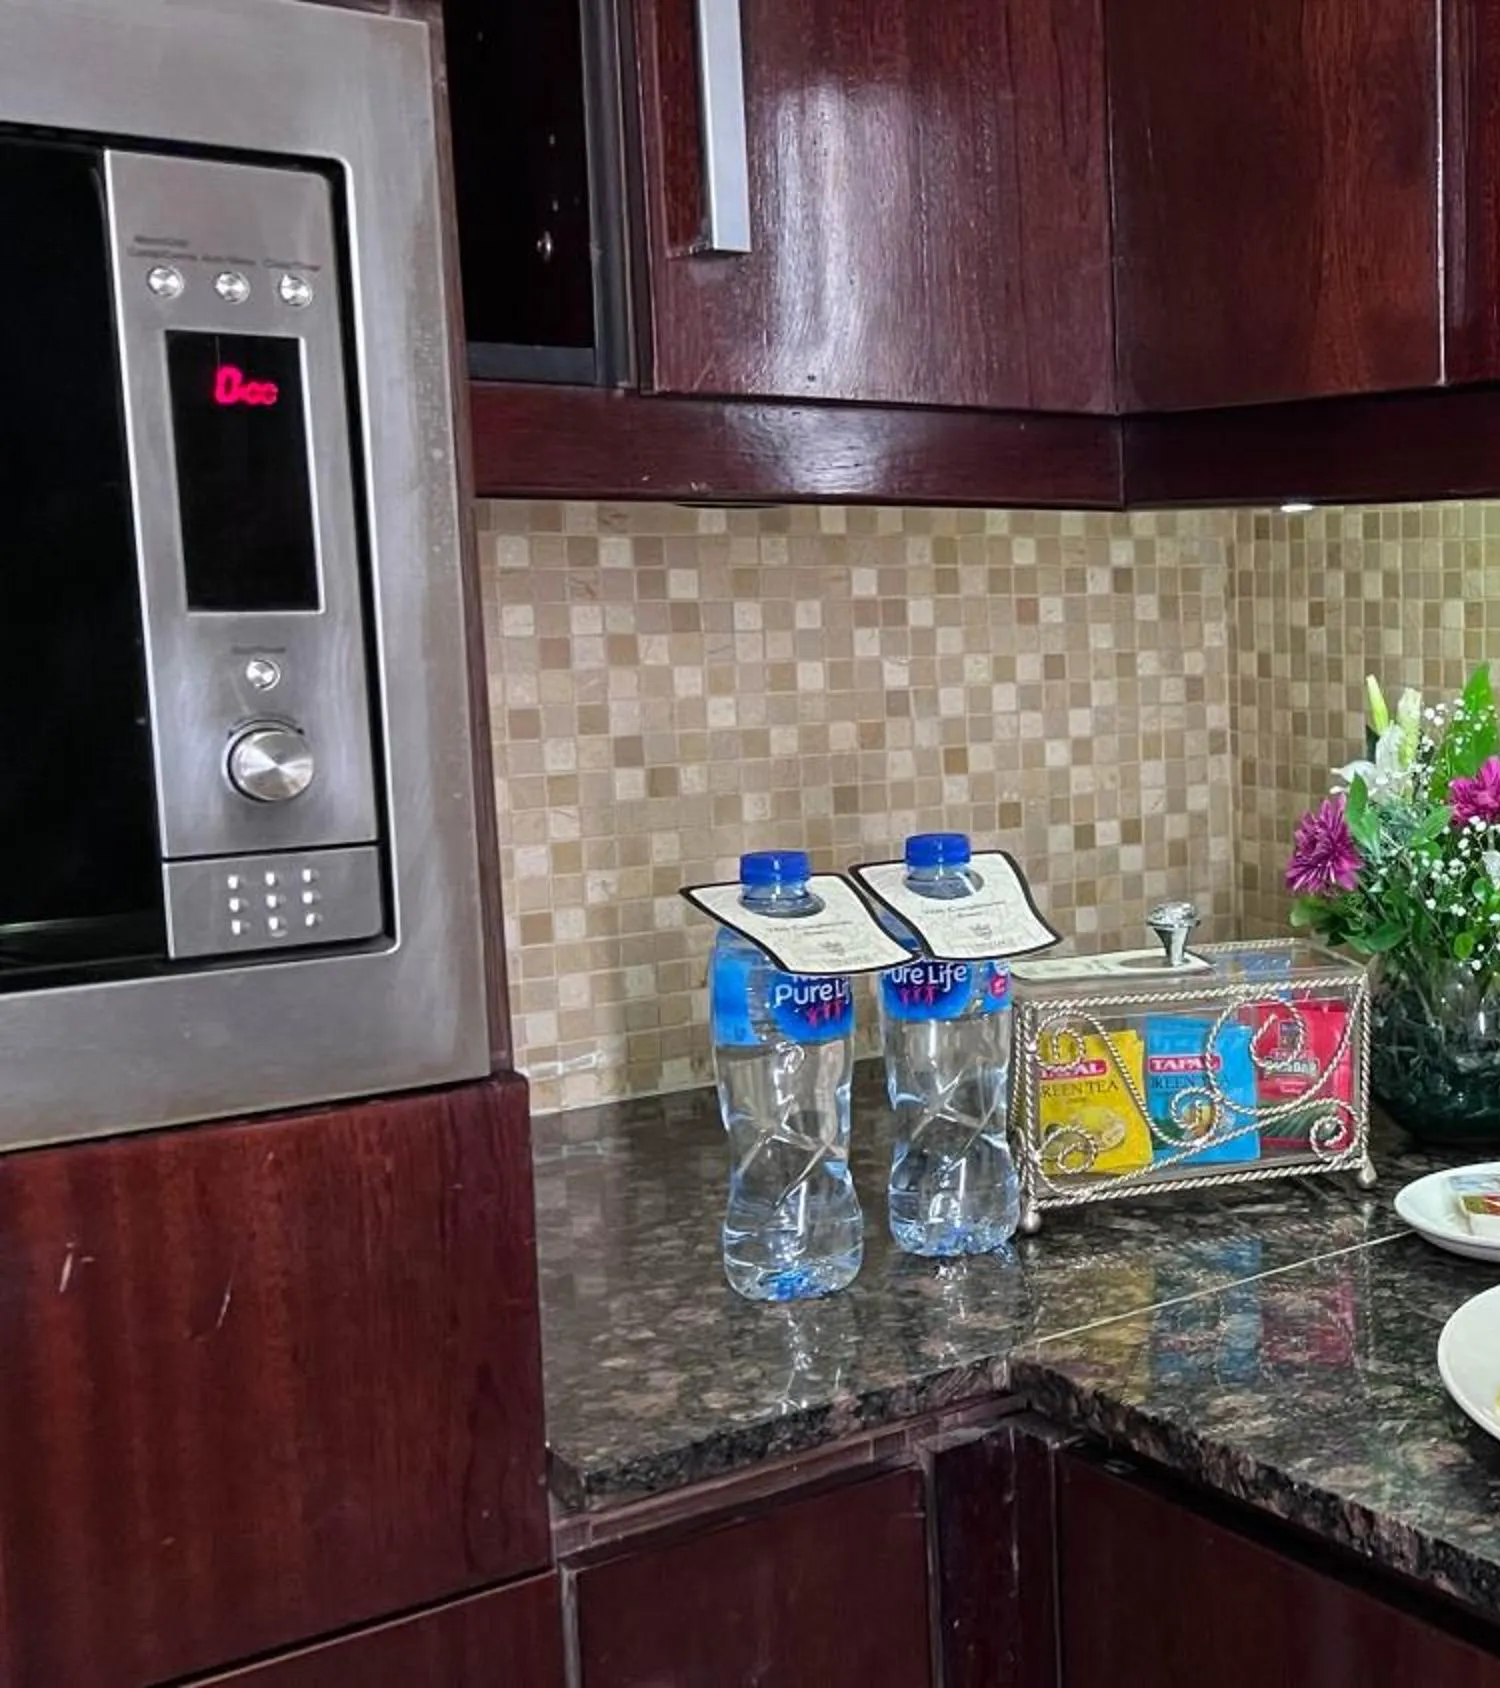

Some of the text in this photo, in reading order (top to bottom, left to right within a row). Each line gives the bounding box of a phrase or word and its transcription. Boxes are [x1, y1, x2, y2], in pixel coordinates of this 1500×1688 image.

[928, 962, 967, 992] Life
[773, 982, 833, 1008] Pure
[1040, 1082, 1083, 1097] REEN
